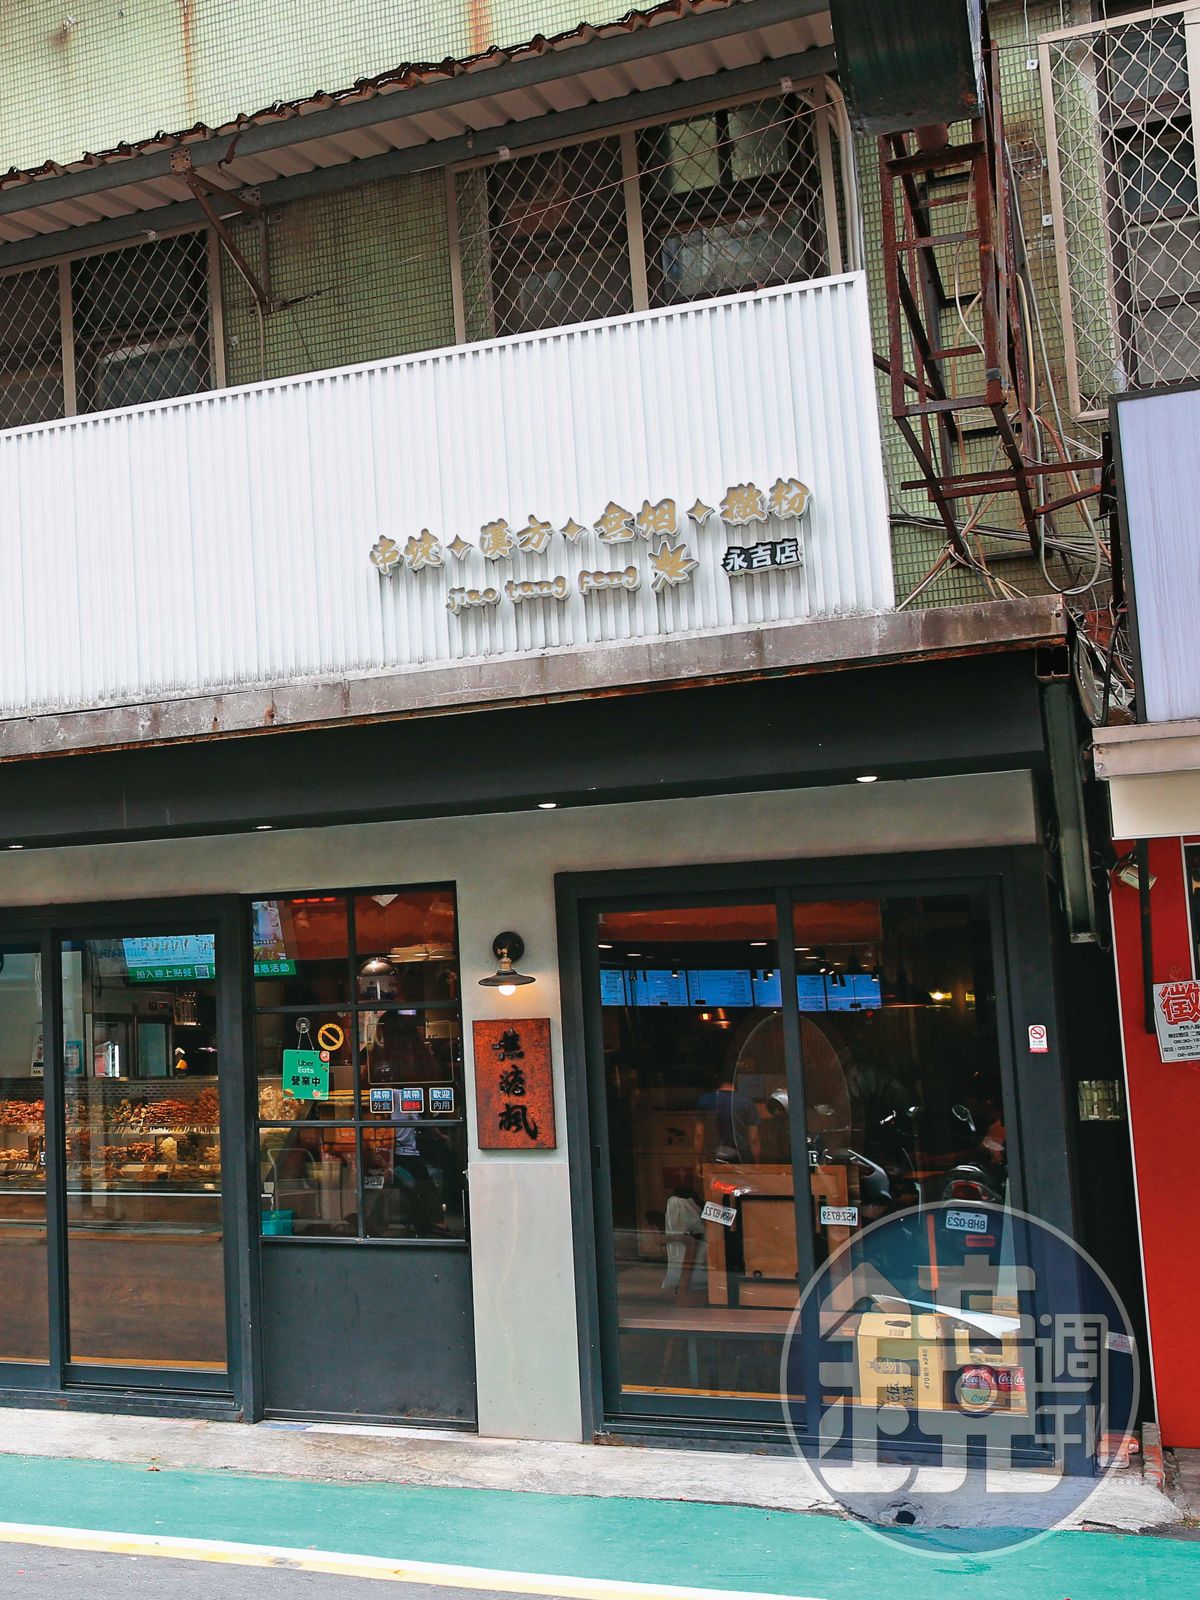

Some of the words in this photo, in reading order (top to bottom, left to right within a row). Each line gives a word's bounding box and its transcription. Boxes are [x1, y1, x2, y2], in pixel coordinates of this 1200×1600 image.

[723, 538, 801, 572] 永吉店
[446, 587, 500, 615] jiao
[505, 575, 570, 603] tang
[578, 565, 641, 595] feng
[291, 1076, 321, 1087] 營業中
[373, 1090, 391, 1099] 禁帶
[432, 1089, 450, 1099] 歡迎
[373, 1101, 391, 1110] 外食
